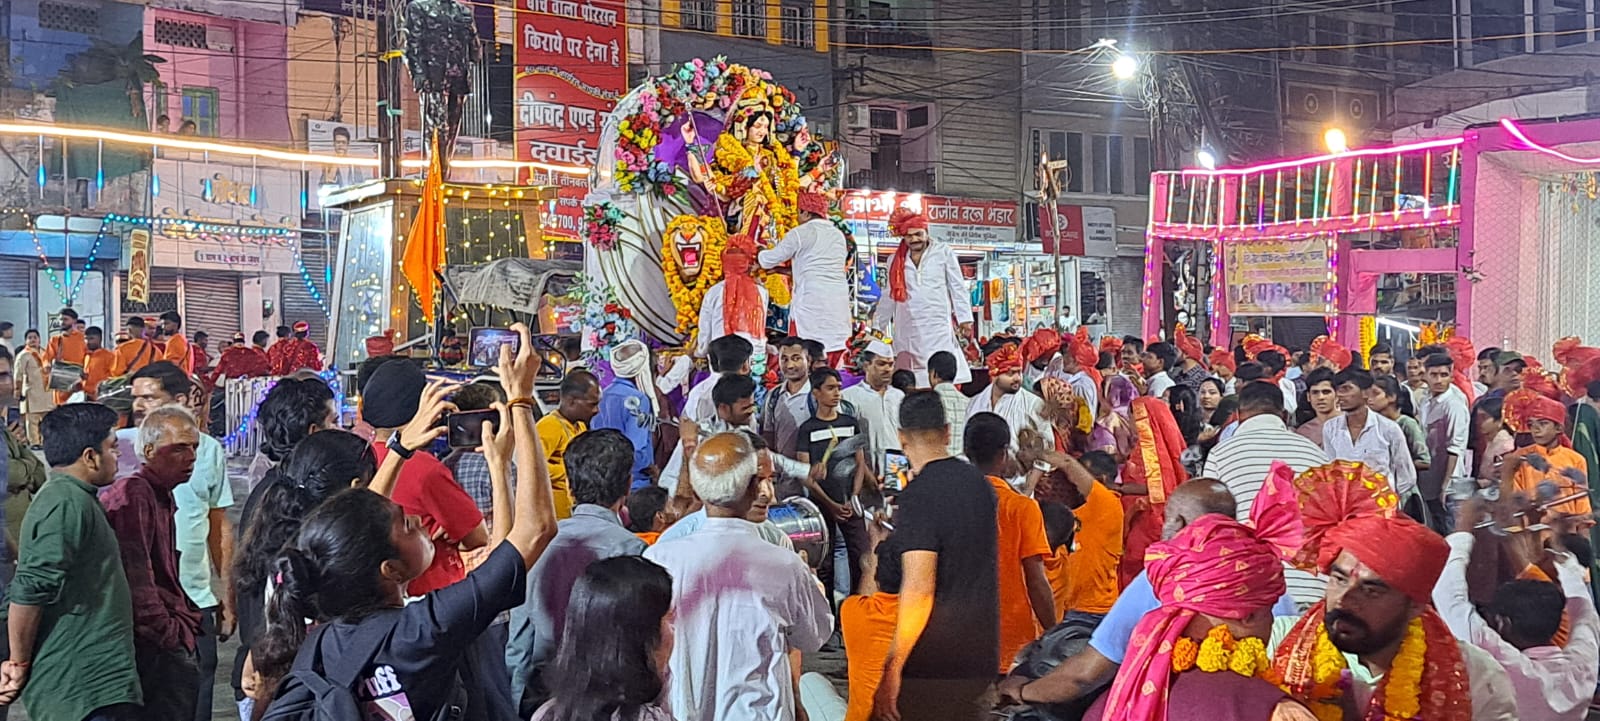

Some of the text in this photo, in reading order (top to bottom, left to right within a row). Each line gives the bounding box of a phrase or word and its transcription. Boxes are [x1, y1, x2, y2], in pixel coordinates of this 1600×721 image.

[524, 24, 620, 68] किराये पर देना है
[518, 90, 565, 132] दीपचंद
[567, 105, 596, 133] एण्ड
[928, 199, 959, 220] राजीव
[988, 202, 1014, 224] भंडार
